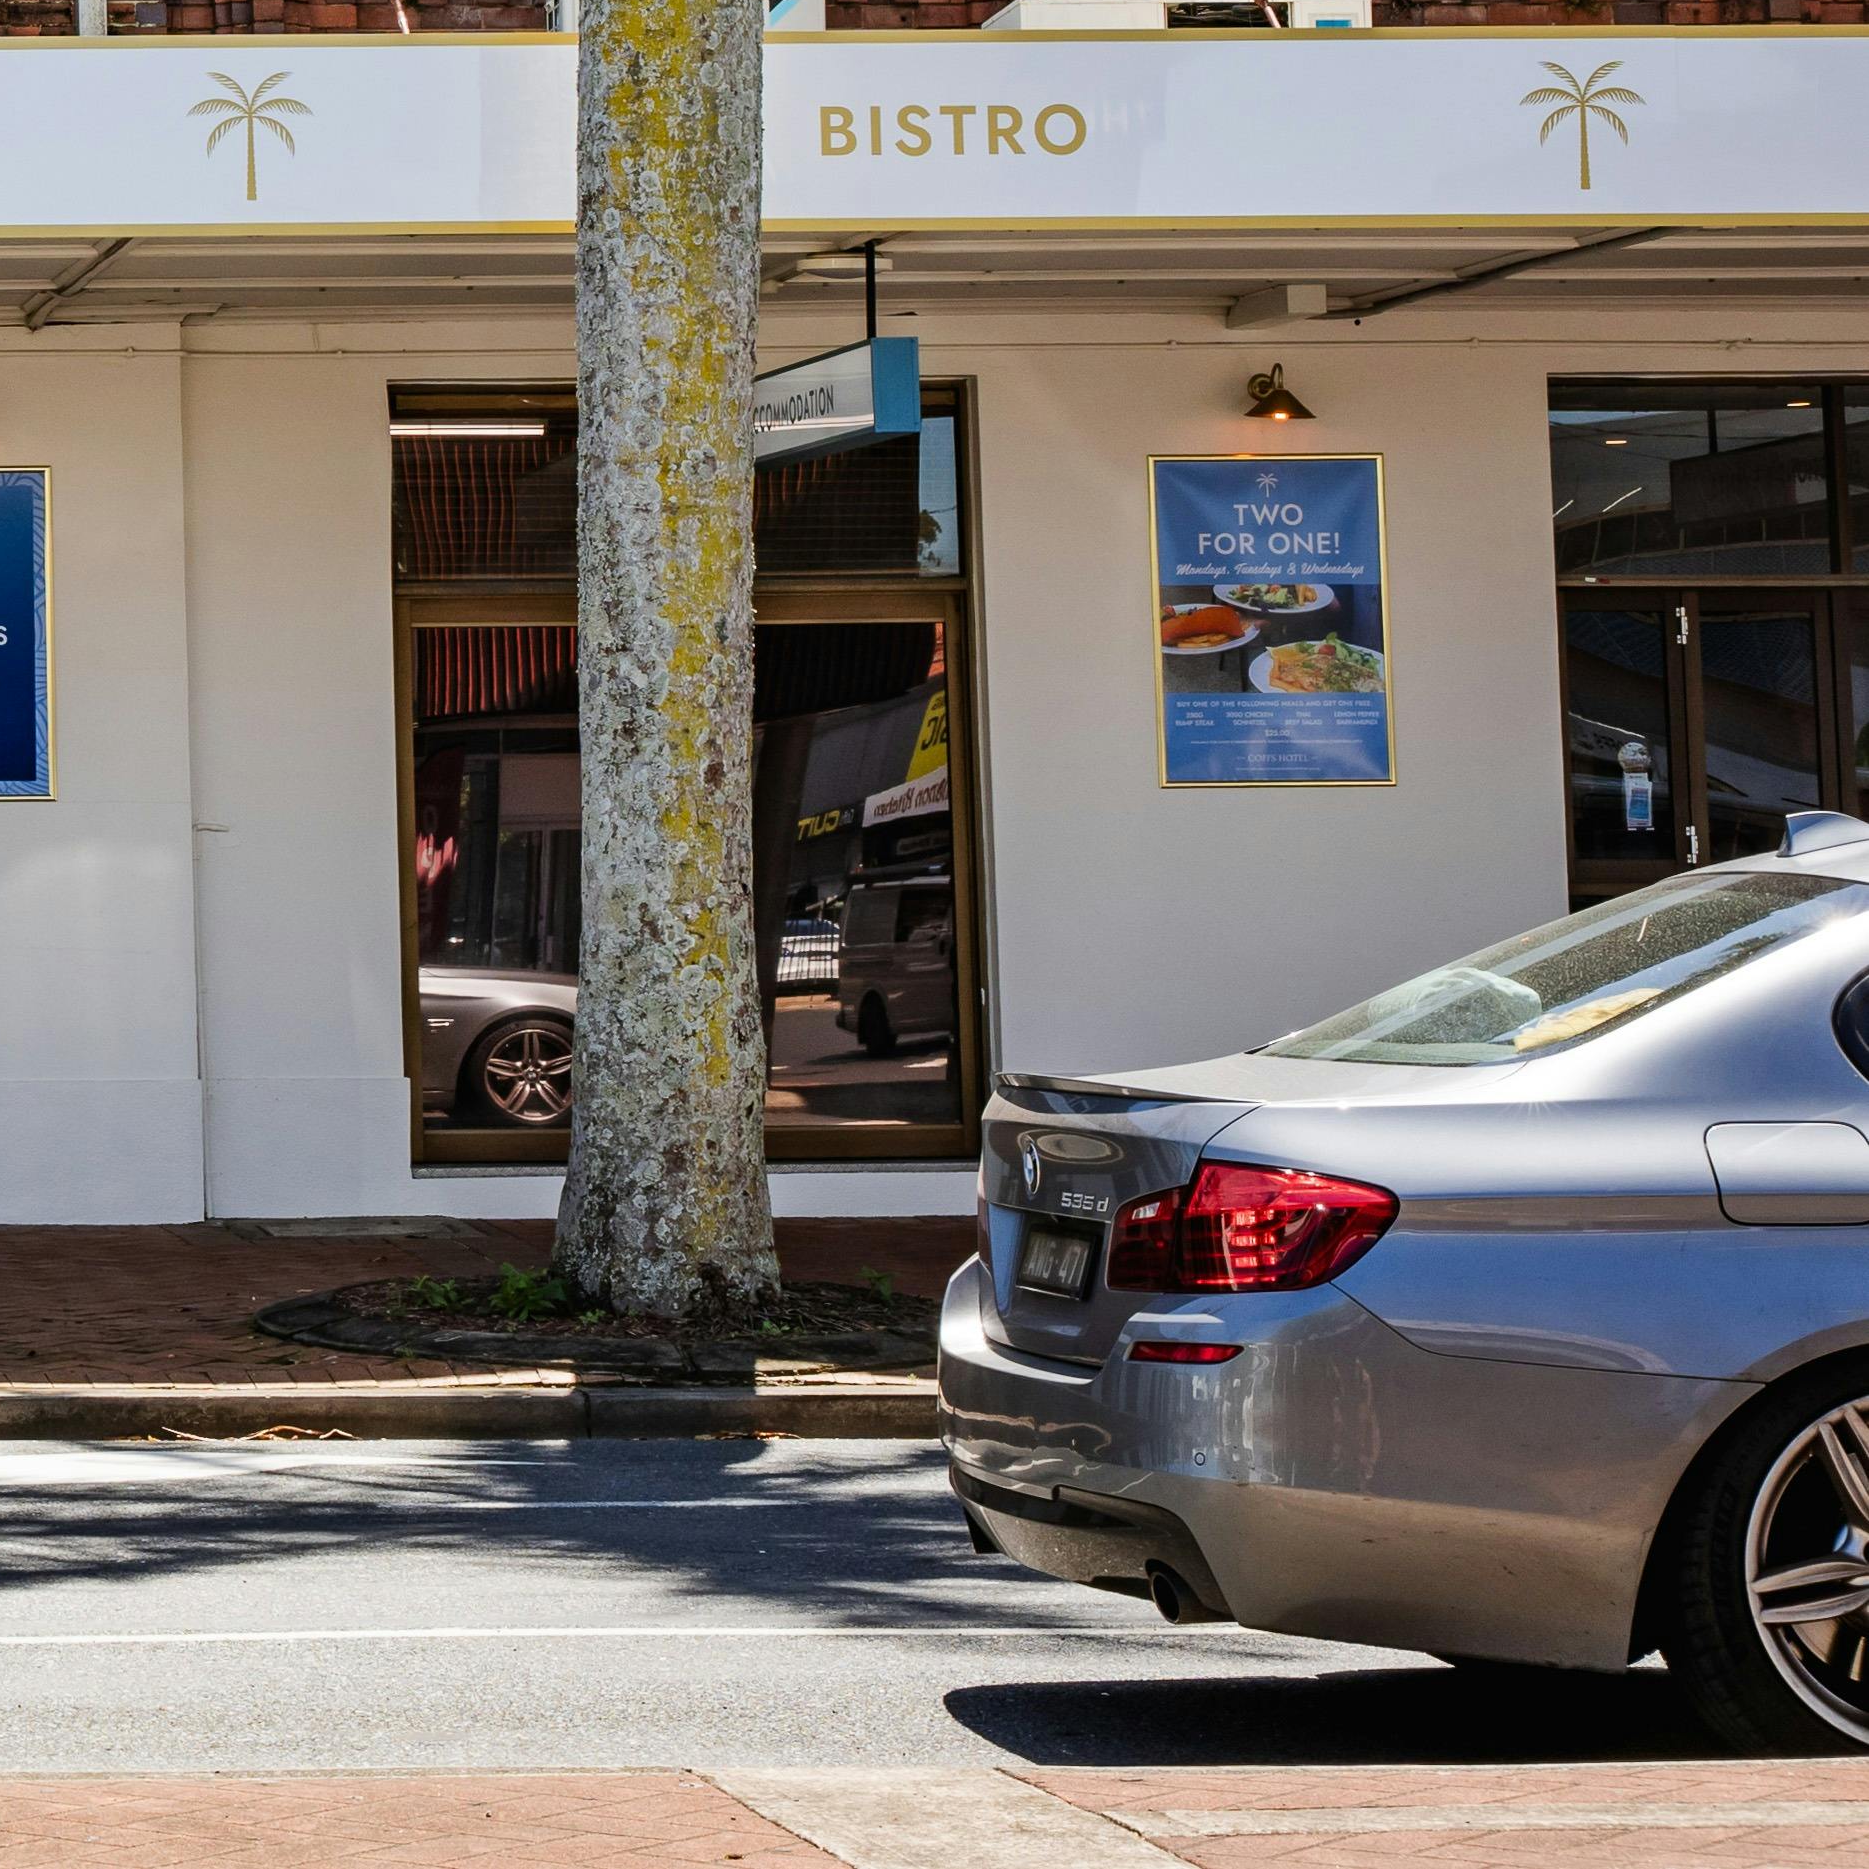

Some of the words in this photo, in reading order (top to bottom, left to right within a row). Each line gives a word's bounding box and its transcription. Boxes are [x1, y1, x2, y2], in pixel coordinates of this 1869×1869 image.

[819, 101, 1087, 158] BISTRO
[753, 384, 834, 434] CCOMMODATION
[1233, 503, 1303, 526] TWO
[1198, 533, 1255, 555] FOR
[1268, 532, 1340, 555] ONE!
[1234, 562, 1282, 578] Tuesdays
[1301, 562, 1364, 579] Wednesdays
